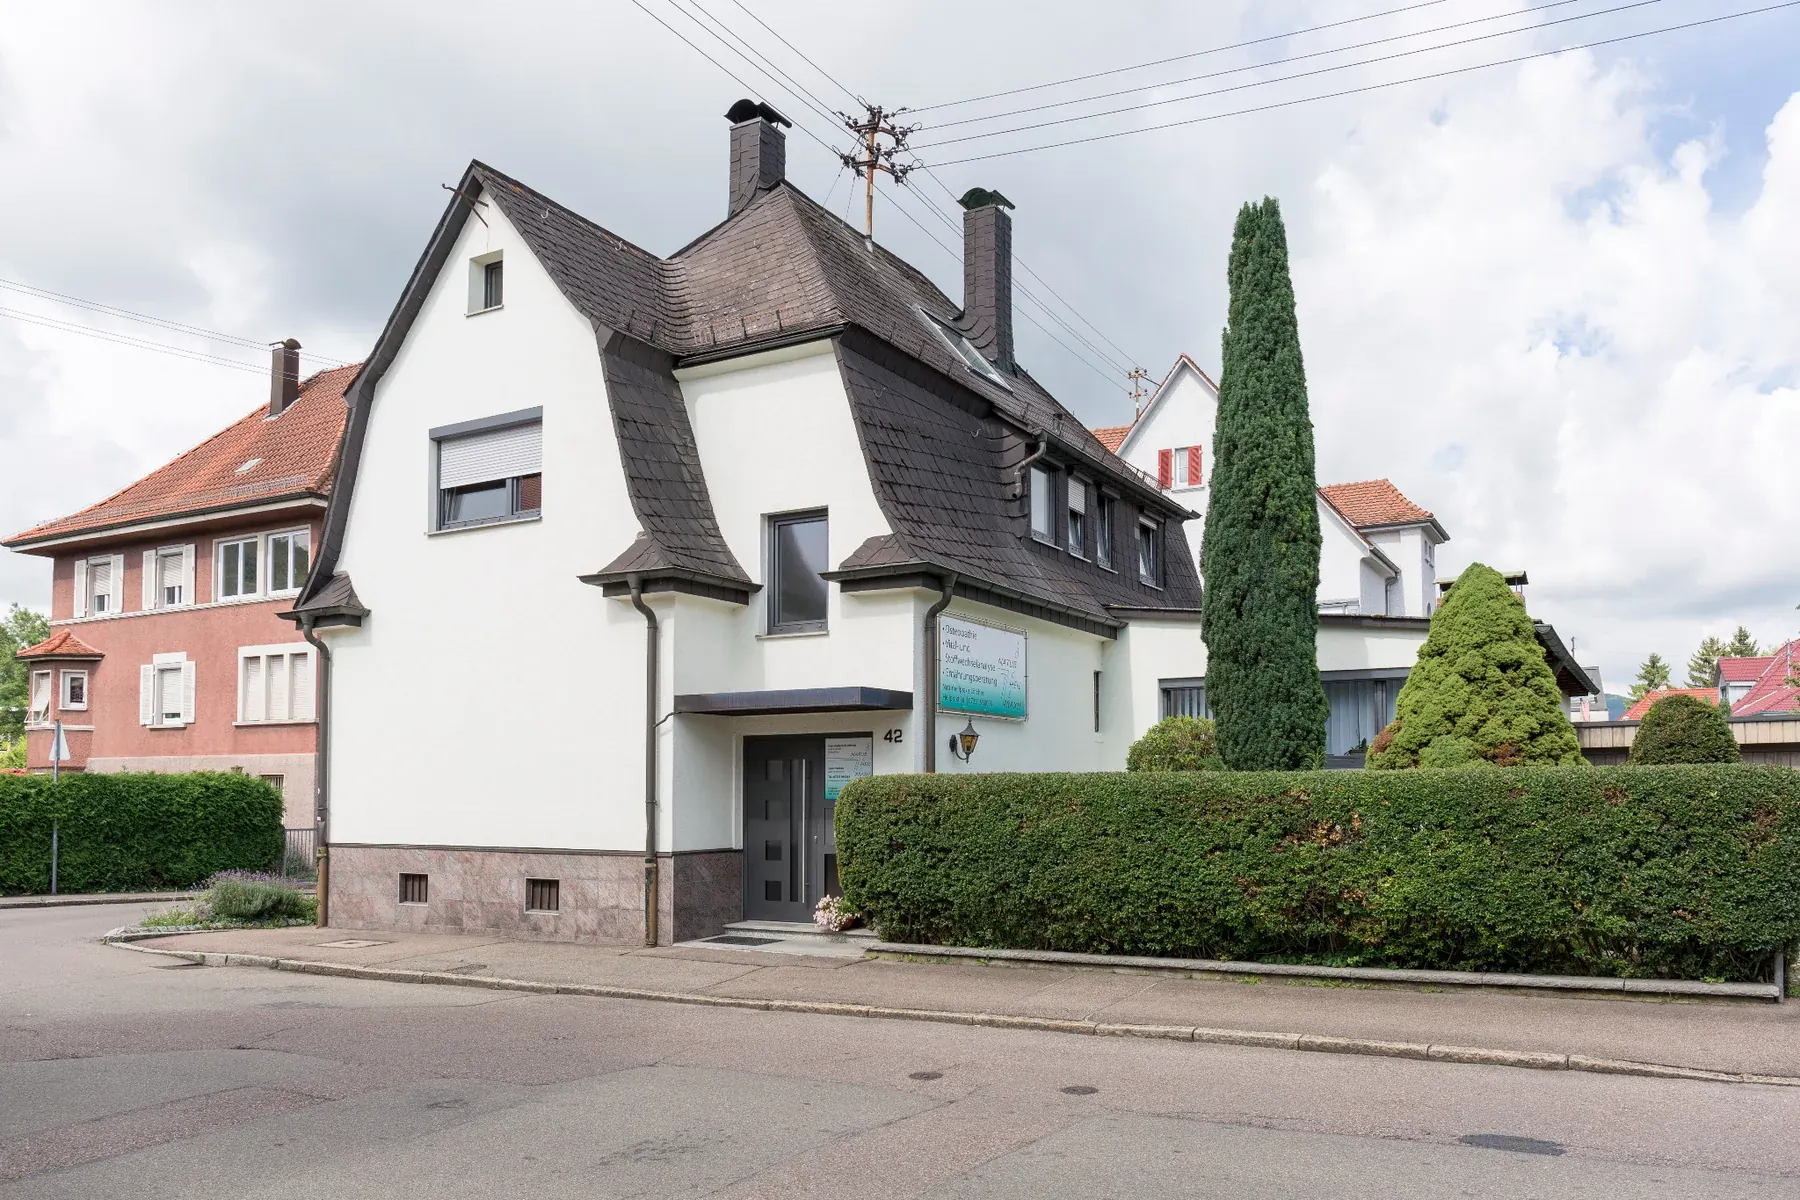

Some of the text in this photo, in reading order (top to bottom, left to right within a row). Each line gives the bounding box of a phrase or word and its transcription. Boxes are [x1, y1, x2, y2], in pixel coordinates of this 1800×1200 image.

[945, 624, 977, 640] Osteopathie
[945, 653, 996, 672] Stoffwechselanalyse
[946, 667, 998, 687] Ernährungsberatung
[883, 728, 903, 743] 42
